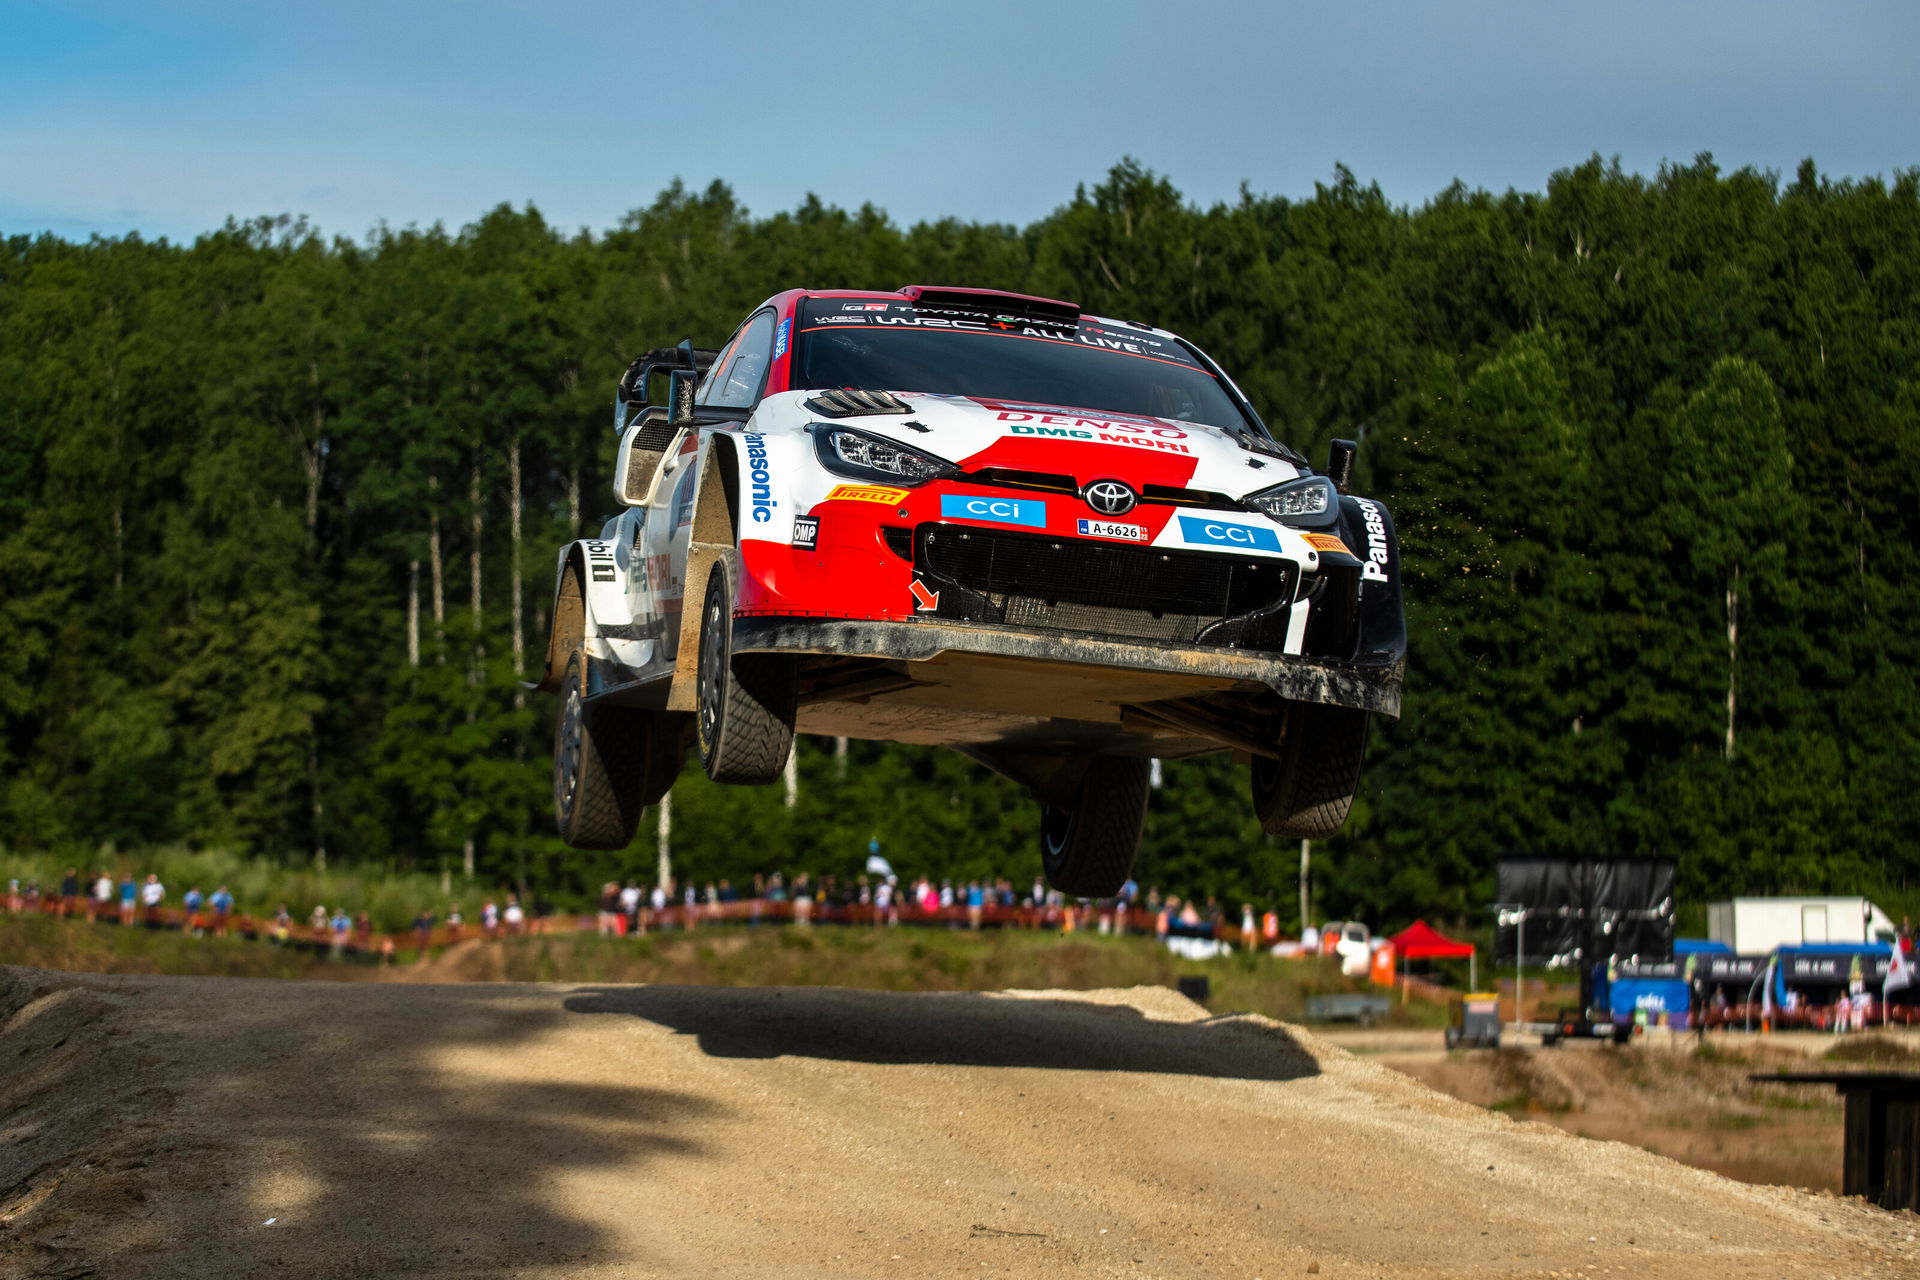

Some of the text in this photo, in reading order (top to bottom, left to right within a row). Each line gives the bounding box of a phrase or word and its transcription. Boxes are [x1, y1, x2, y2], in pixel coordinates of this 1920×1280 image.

[844, 303, 887, 311] GR
[895, 306, 990, 318] TOYOTA
[1085, 327, 1162, 347] Racing
[1022, 327, 1075, 342] ALL
[1079, 335, 1142, 354] LIVE
[996, 411, 1189, 440] DENSO
[1010, 425, 1190, 454] DMG MORI
[744, 432, 777, 523] anasonic
[831, 486, 902, 502] PIRELLI
[794, 523, 816, 542] OMP
[1093, 523, 1138, 538] A-6626
